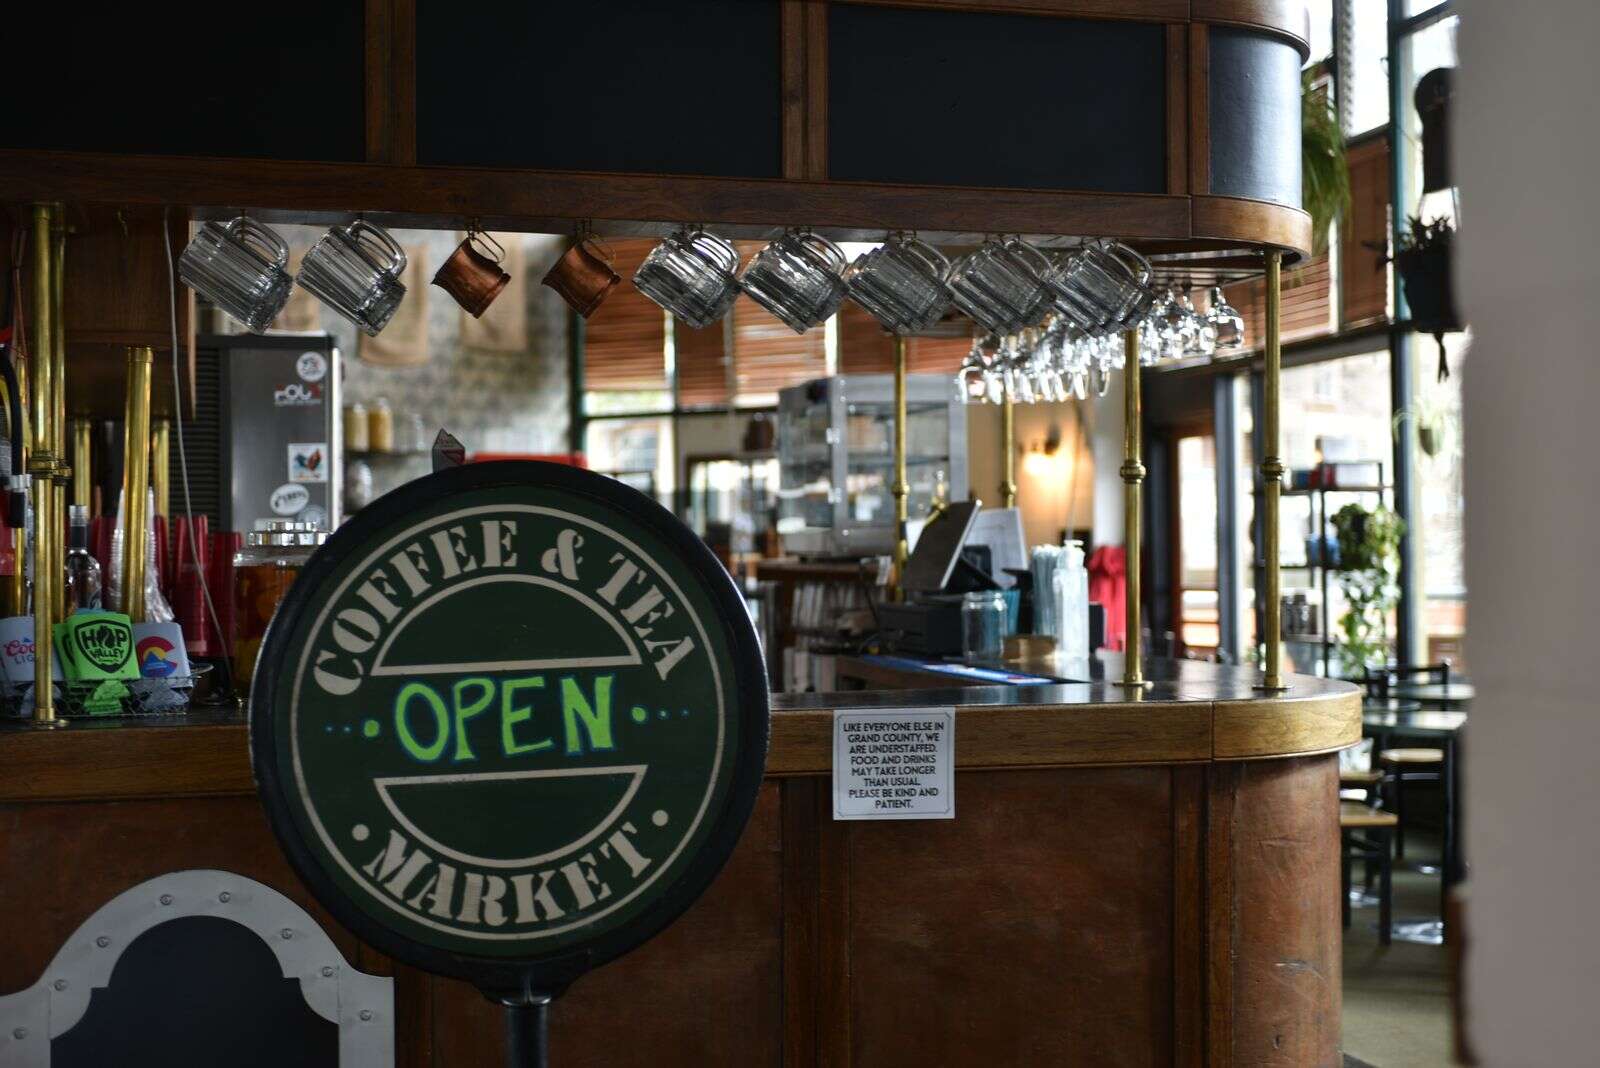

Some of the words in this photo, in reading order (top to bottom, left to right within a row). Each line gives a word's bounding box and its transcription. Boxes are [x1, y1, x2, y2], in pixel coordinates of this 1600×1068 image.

[313, 519, 519, 696] COFFEE
[541, 528, 585, 581] &
[596, 552, 698, 681] TEA
[4, 640, 35, 656] Coo
[394, 674, 616, 762] OPEN
[843, 723, 861, 732] LIKE
[864, 722, 911, 732] EVERYONE
[914, 722, 932, 731] ELSE
[935, 722, 944, 730] IN
[848, 734, 880, 743] GRAND
[883, 733, 924, 743] COUNTY,
[926, 733, 940, 741] WE
[850, 745, 867, 754] ARE
[869, 744, 937, 753] UNDERSTAFFED.
[851, 756, 879, 765] FOOD
[882, 756, 901, 764] AND
[903, 755, 936, 763] DRINKS
[852, 767, 873, 776] MAY
[875, 767, 896, 775] TAKE
[899, 766, 935, 775] LONGER
[864, 779, 888, 787] THAN
[849, 789, 880, 798] PLEASE
[882, 789, 892, 797] BE
[895, 788, 917, 797] KIND
[919, 788, 938, 796] AND
[875, 800, 913, 808] PATIENT.
[361, 821, 652, 926] MARKET
